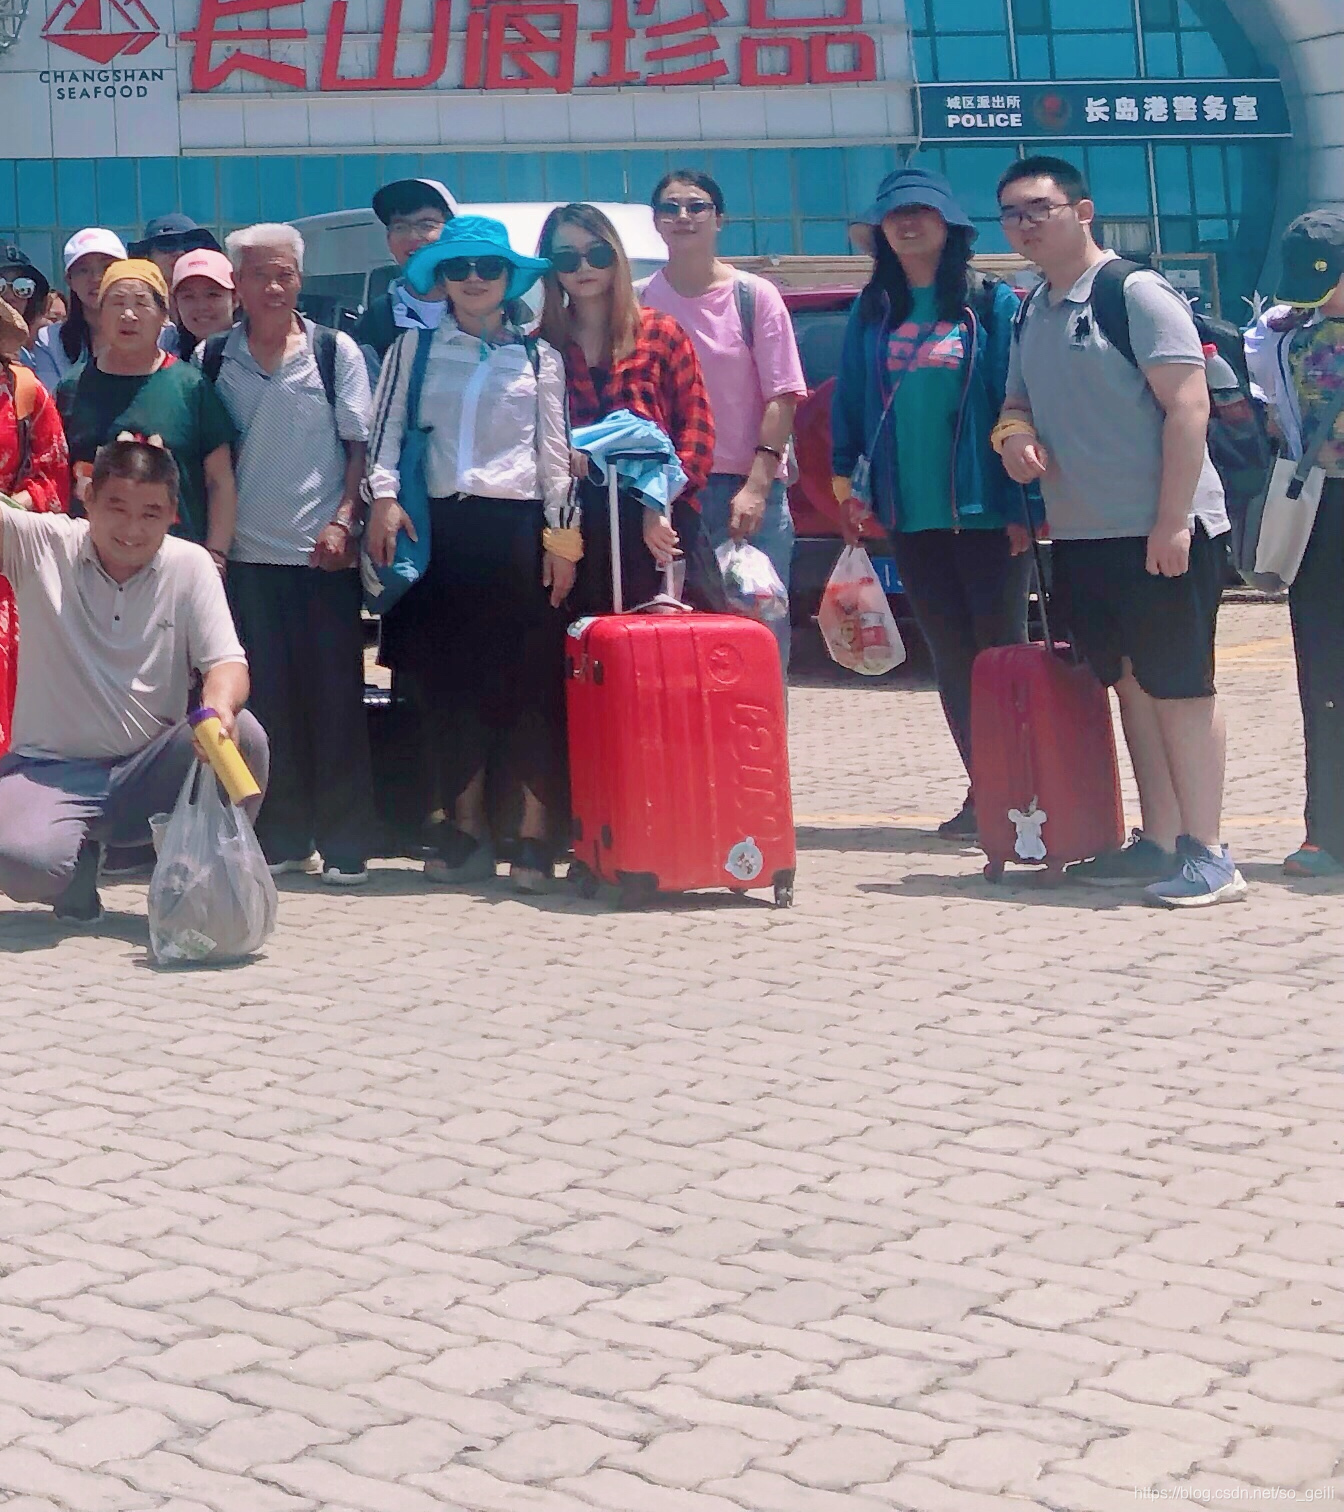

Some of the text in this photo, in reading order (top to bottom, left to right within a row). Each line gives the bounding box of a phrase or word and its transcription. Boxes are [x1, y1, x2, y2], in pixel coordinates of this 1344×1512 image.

[39, 69, 165, 83] CHANGSHAN
[56, 85, 148, 100] SEAFOOD
[946, 94, 1021, 110] 城区派出所
[1084, 93, 1259, 123] 长岛港警务室
[947, 113, 1023, 128] POLICE
